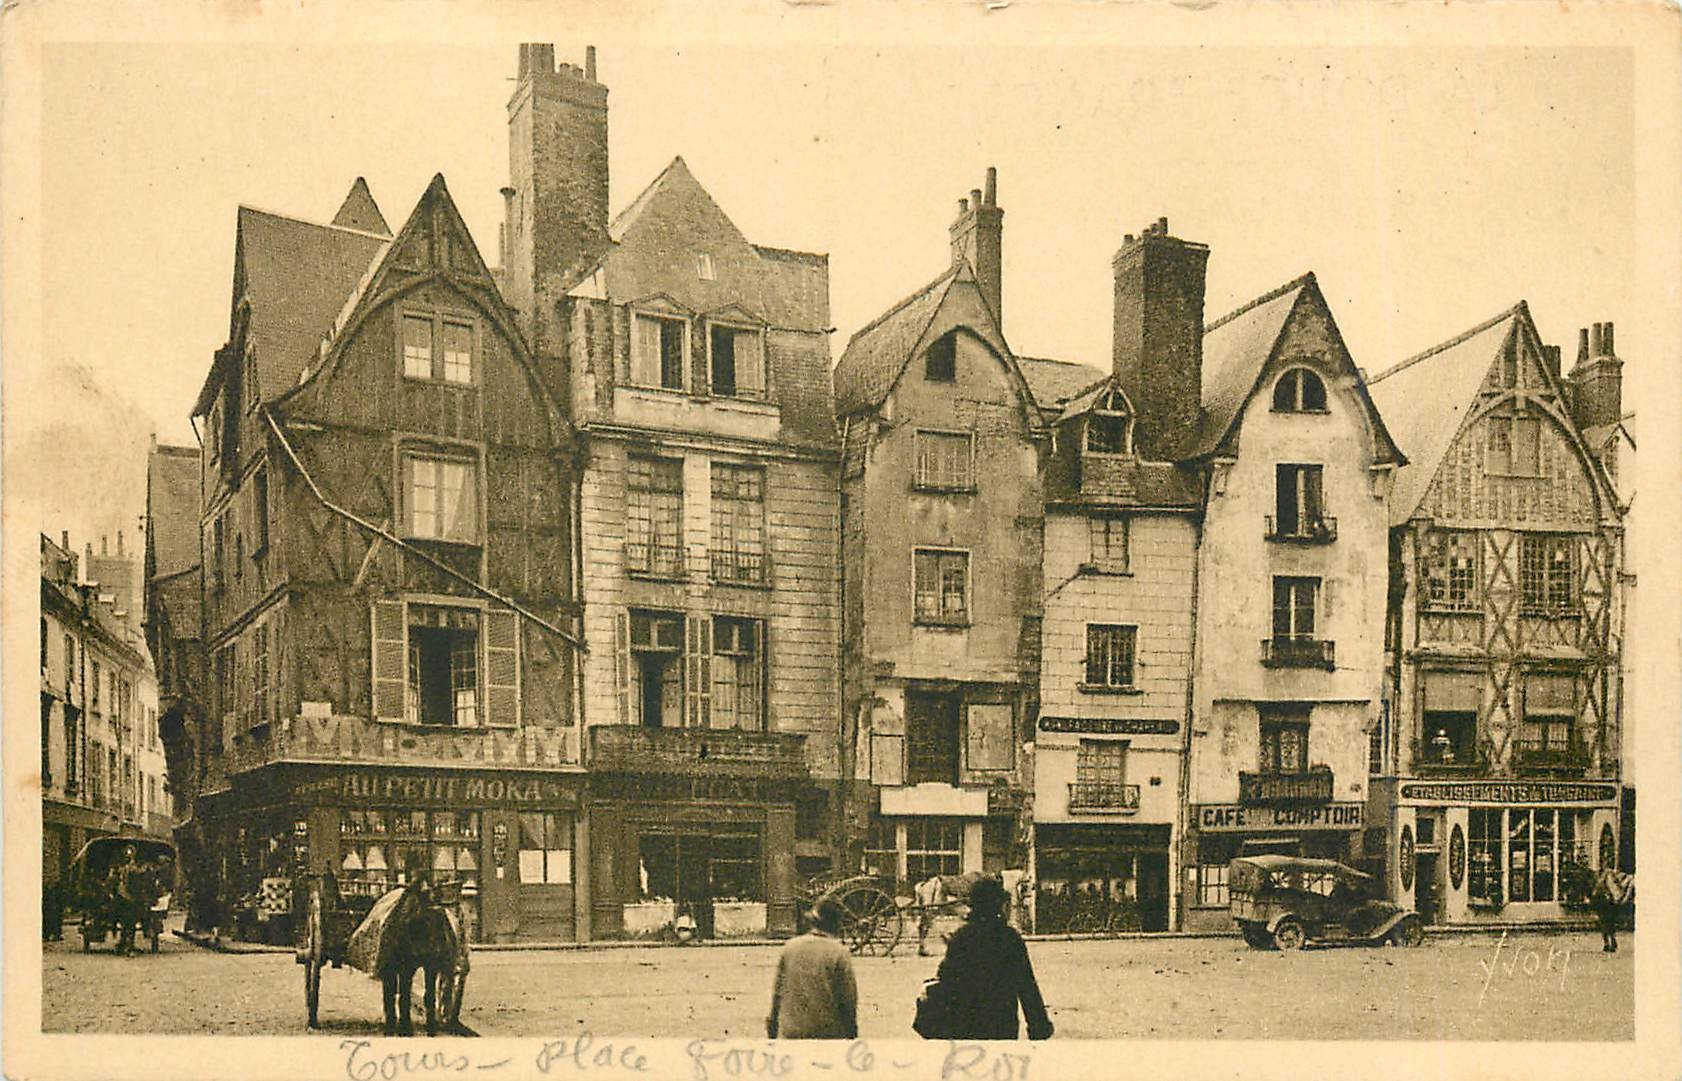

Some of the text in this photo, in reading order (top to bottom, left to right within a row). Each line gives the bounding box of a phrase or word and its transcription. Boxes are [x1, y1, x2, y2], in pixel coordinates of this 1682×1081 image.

[385, 776, 460, 799] PETIT
[465, 779, 542, 801] MOKA
[1274, 805, 1360, 825] COMPTOIR
